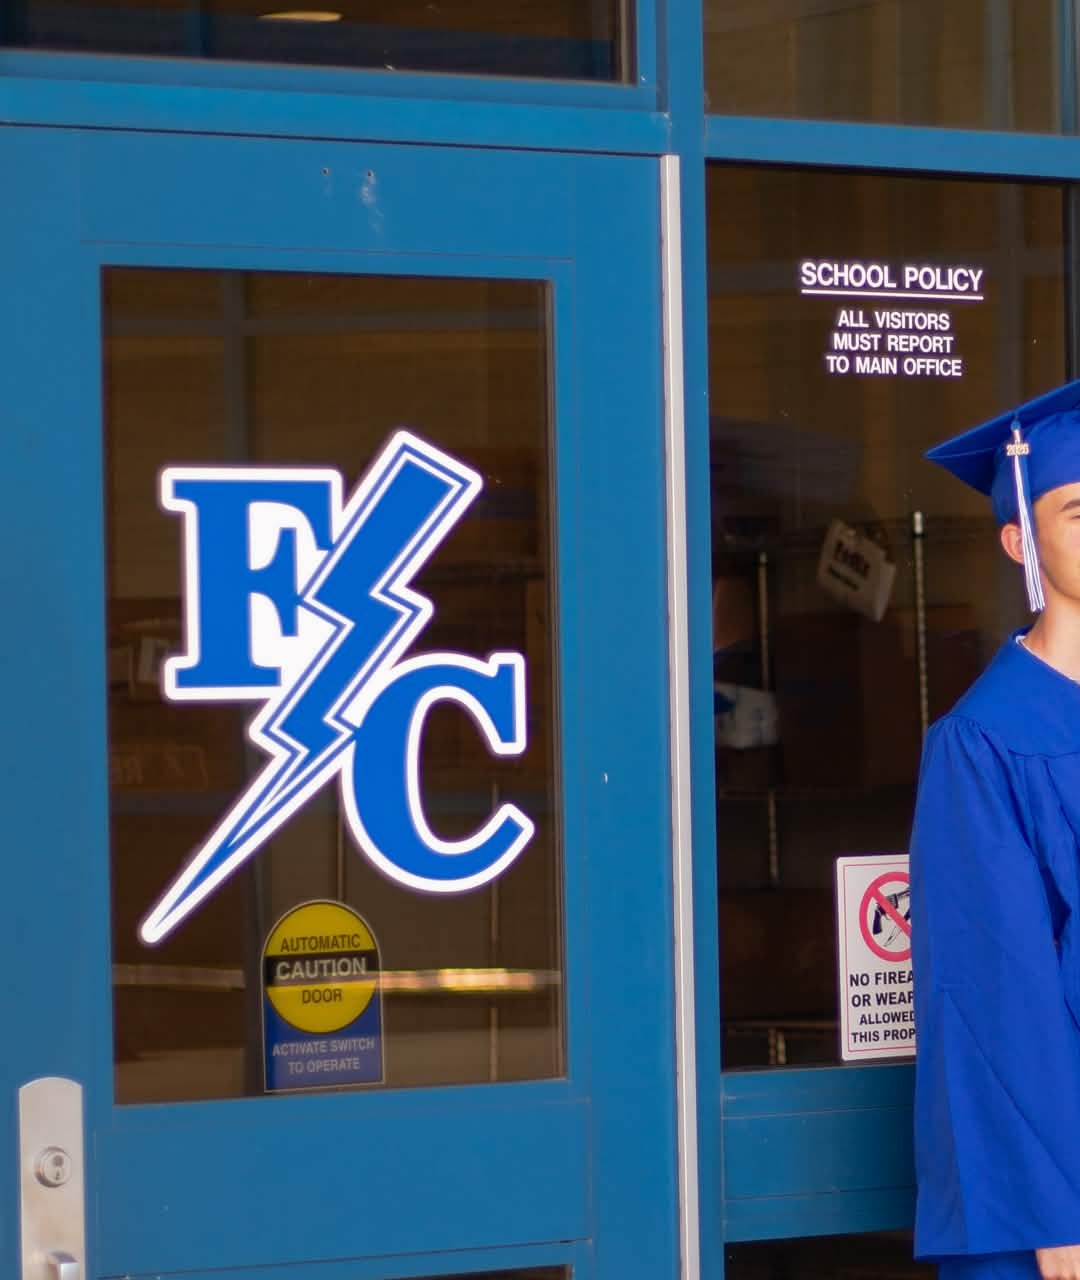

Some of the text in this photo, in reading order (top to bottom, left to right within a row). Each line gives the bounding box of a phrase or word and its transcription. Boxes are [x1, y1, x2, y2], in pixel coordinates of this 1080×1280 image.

[801, 262, 983, 292] SCHOOL POLICY
[838, 310, 951, 331] ALL VISITORS
[833, 332, 954, 353] MUST REPORT
[826, 355, 962, 377] TO MAIN OFFICE
[280, 934, 361, 953] AUTOMATIC
[276, 957, 367, 981] CAUTION
[850, 970, 914, 987] NO FIREA
[301, 988, 342, 1005] DOOR
[851, 993, 872, 1008] OR
[851, 1028, 916, 1043] THIS PROP
[272, 1037, 376, 1057] ACTIVATE SWITCH
[288, 1057, 361, 1075] TO OPERATE
